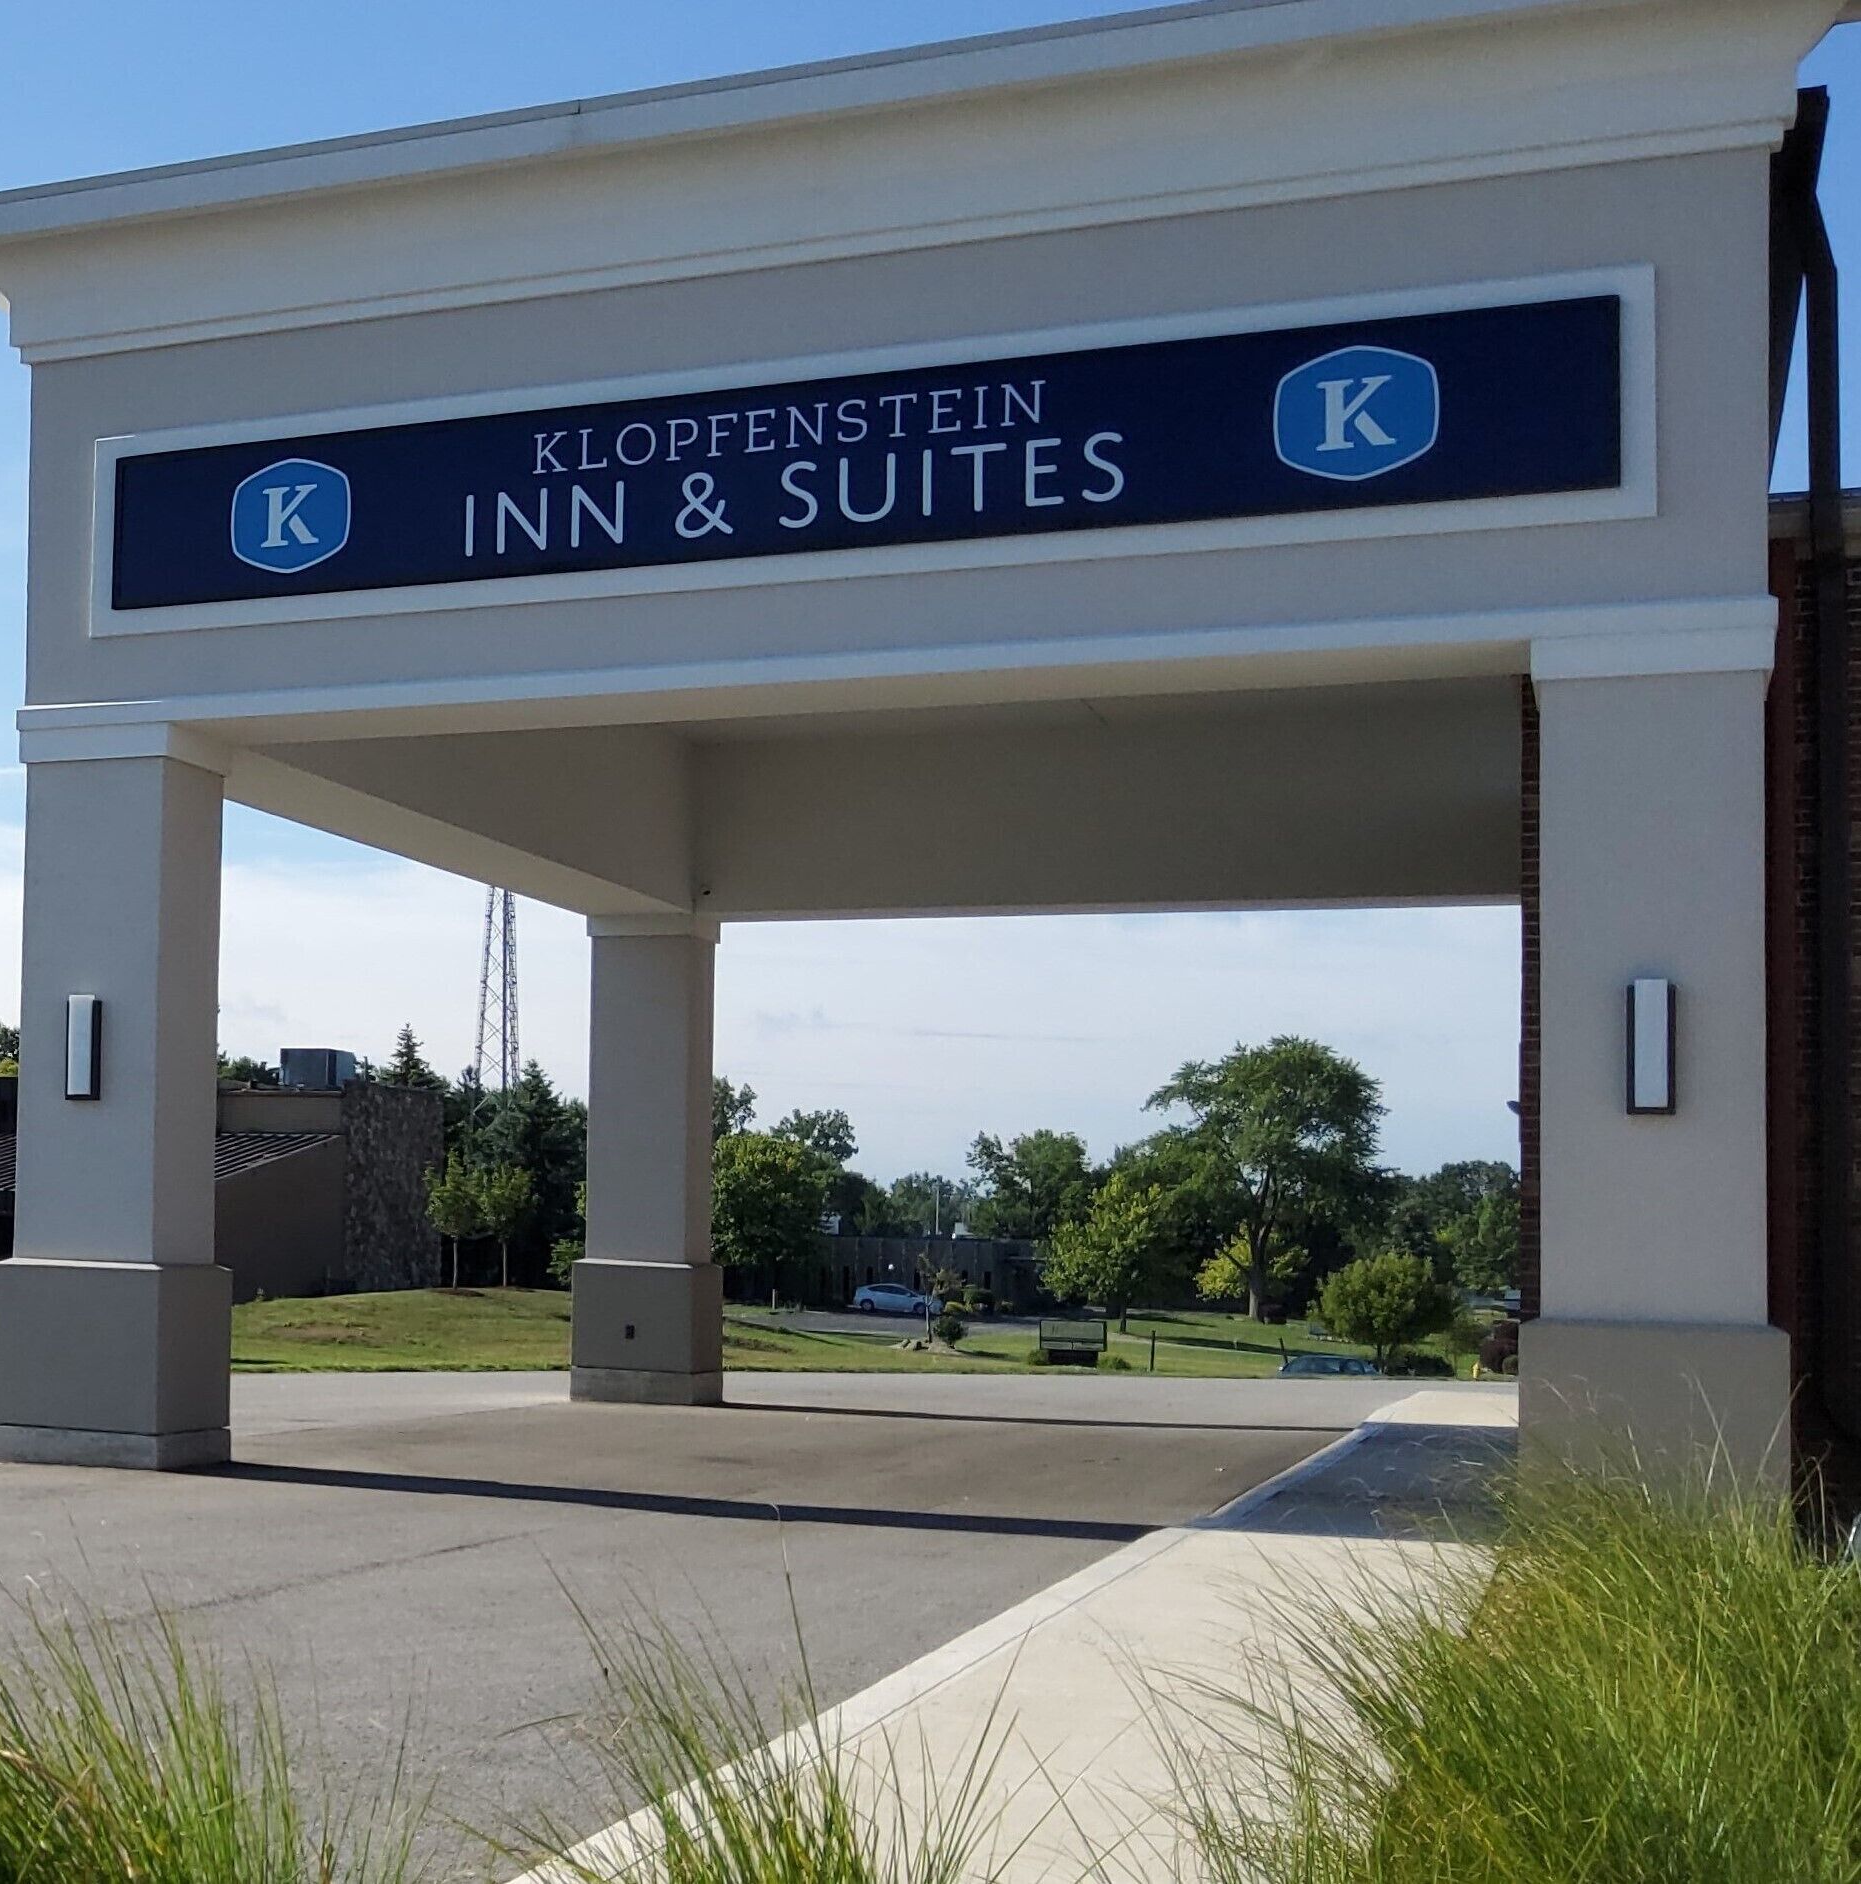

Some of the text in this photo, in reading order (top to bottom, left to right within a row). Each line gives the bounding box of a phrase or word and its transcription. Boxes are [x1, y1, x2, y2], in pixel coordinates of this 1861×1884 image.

[533, 380, 1046, 475] KLOPFENSTEIN
[1314, 374, 1396, 453] K
[260, 483, 319, 548] K
[466, 432, 1126, 557] INN & SUITES
